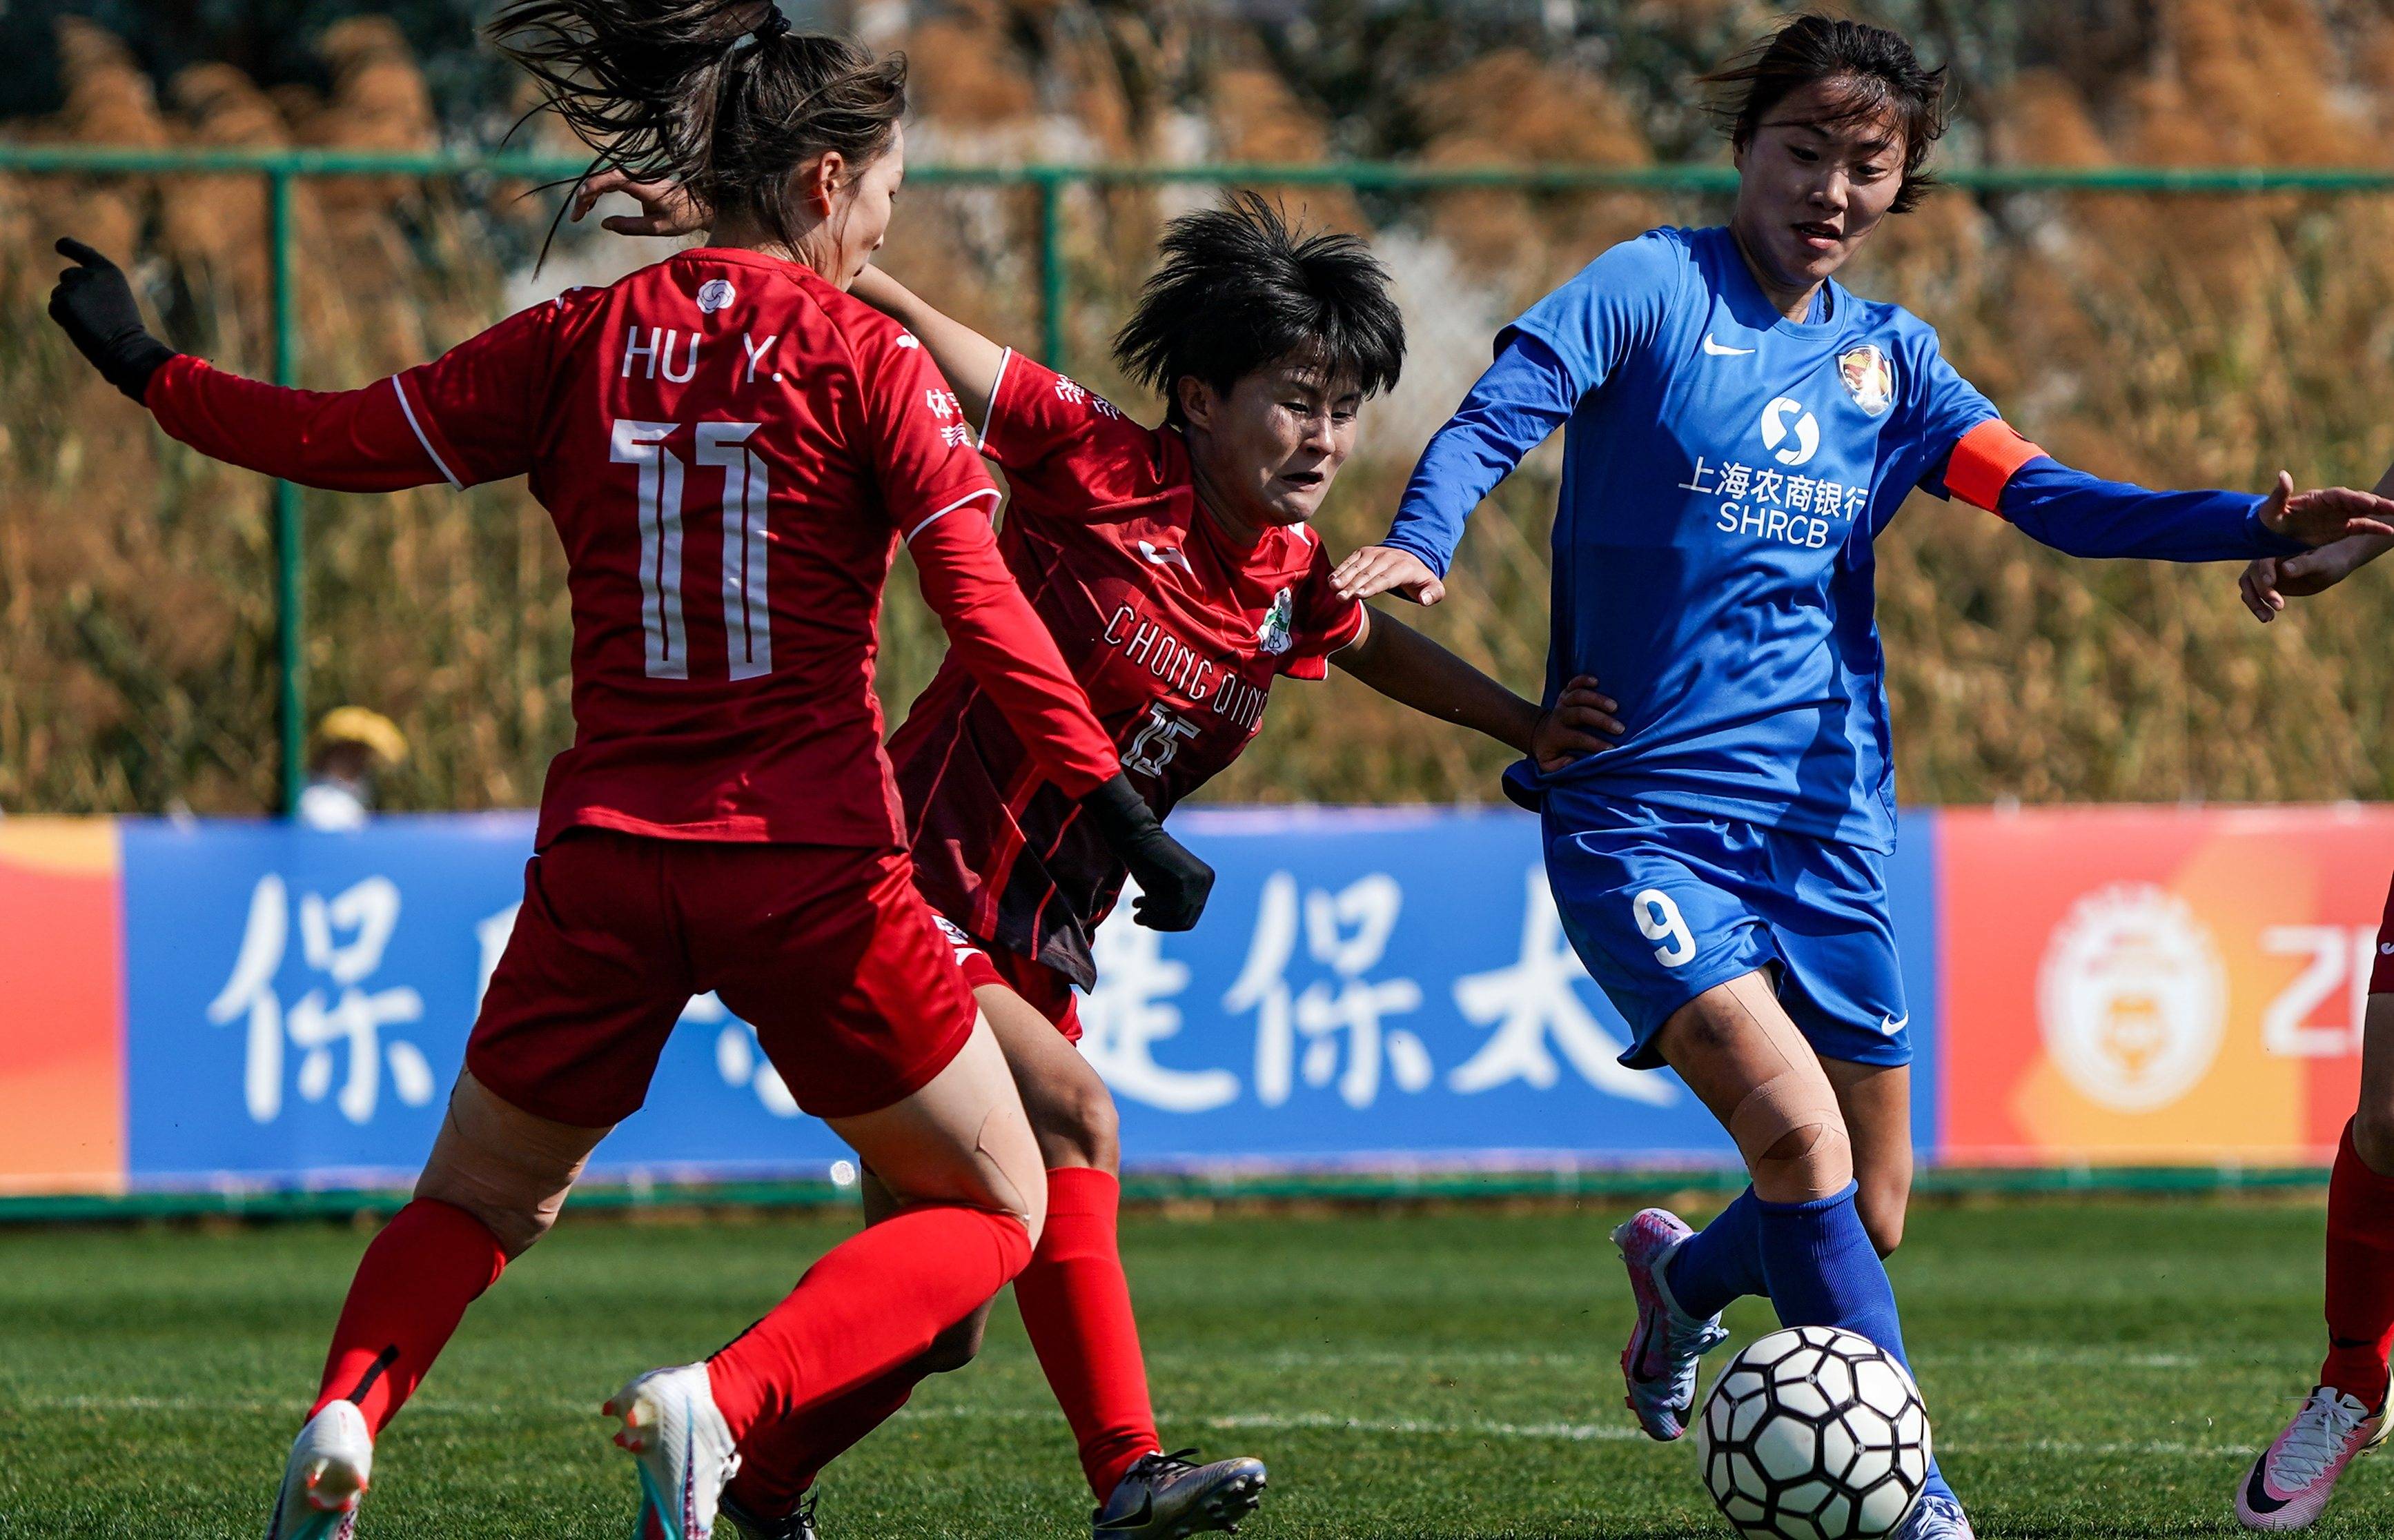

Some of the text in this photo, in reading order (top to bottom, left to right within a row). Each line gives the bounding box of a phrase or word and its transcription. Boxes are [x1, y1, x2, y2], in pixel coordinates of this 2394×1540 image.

[622, 326, 783, 384] HU Y.
[1678, 455, 1869, 522] 上海农商银行
[609, 418, 772, 682] 11
[1716, 502, 1830, 549] SHRCB
[1120, 701, 1201, 779] 15
[1633, 888, 1698, 968] 9
